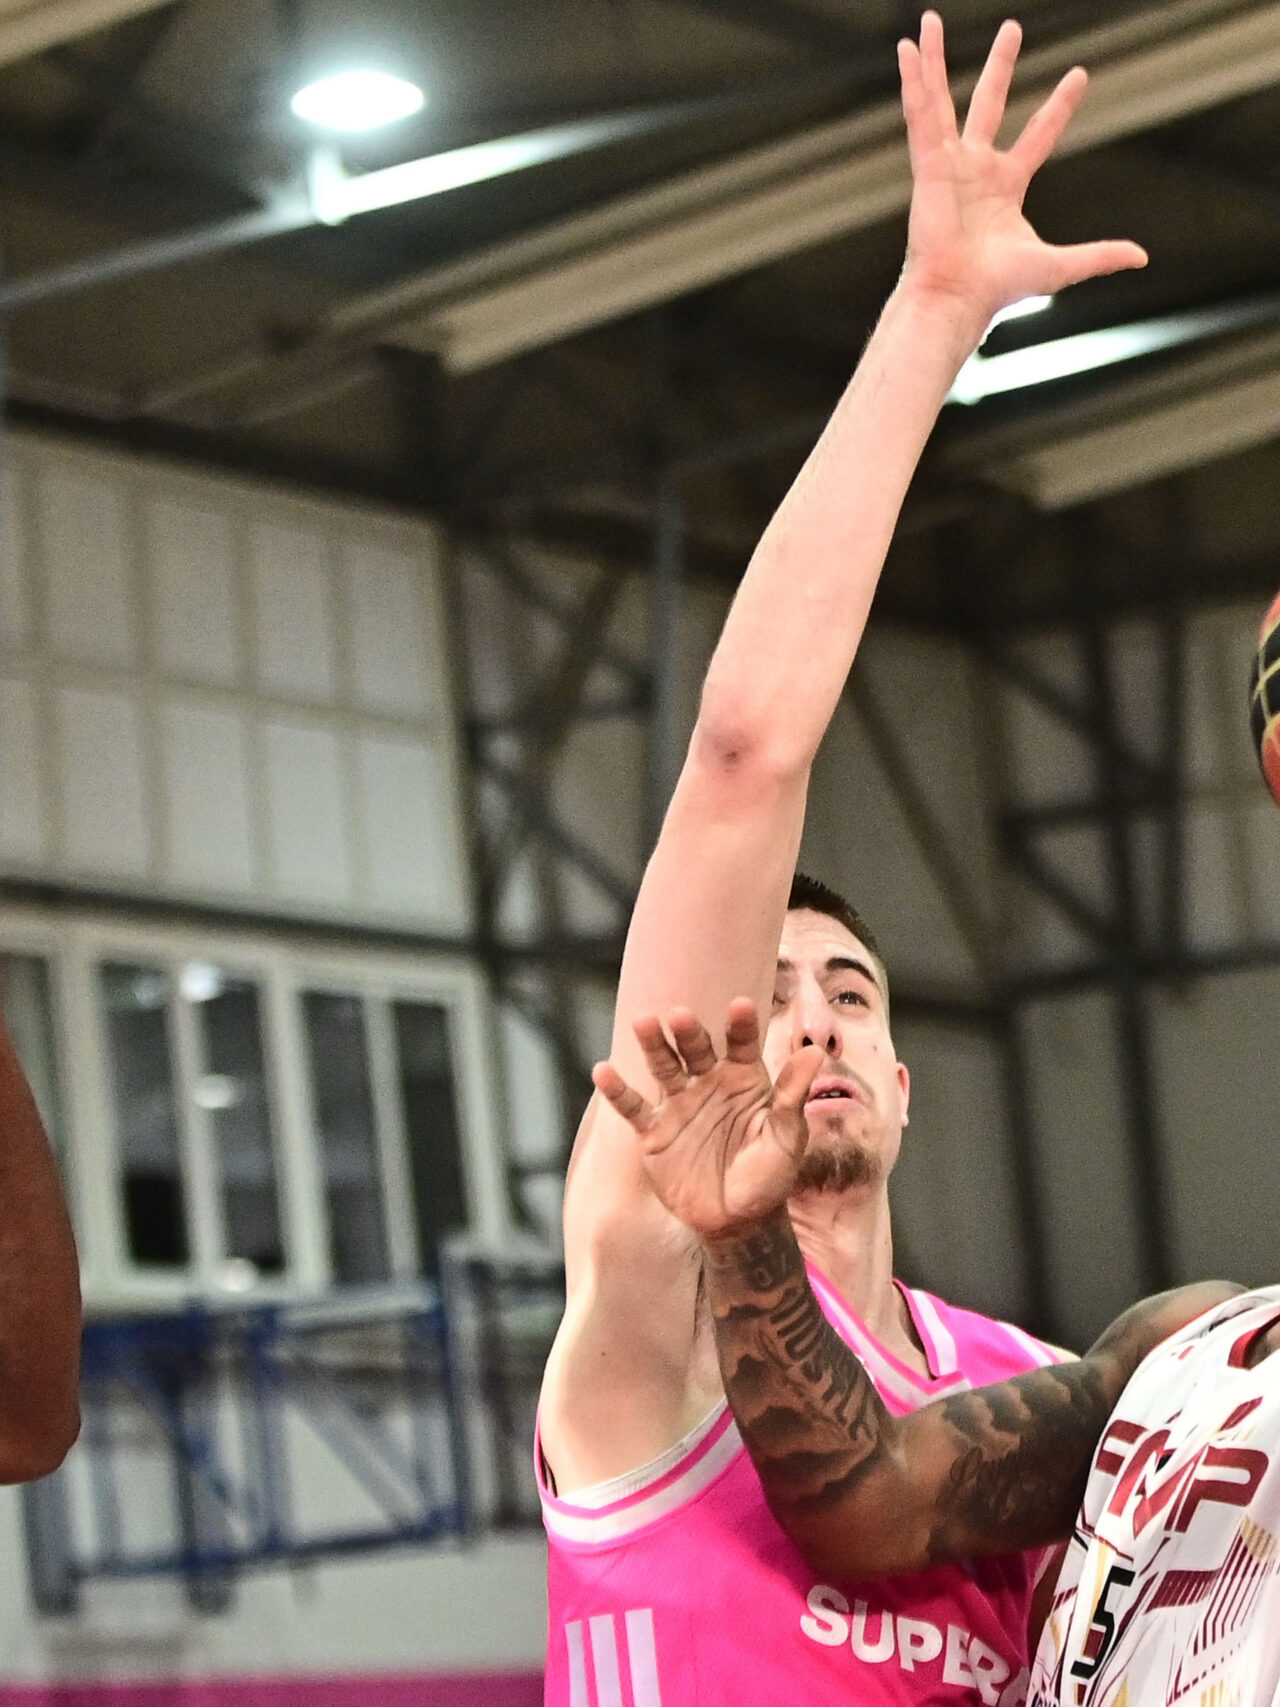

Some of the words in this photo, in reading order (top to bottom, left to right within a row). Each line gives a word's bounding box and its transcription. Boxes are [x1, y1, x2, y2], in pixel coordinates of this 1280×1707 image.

[1094, 1418, 1270, 1541] FMP
[799, 1584, 1030, 1707] SUPER
[1069, 1564, 1136, 1680] 5
